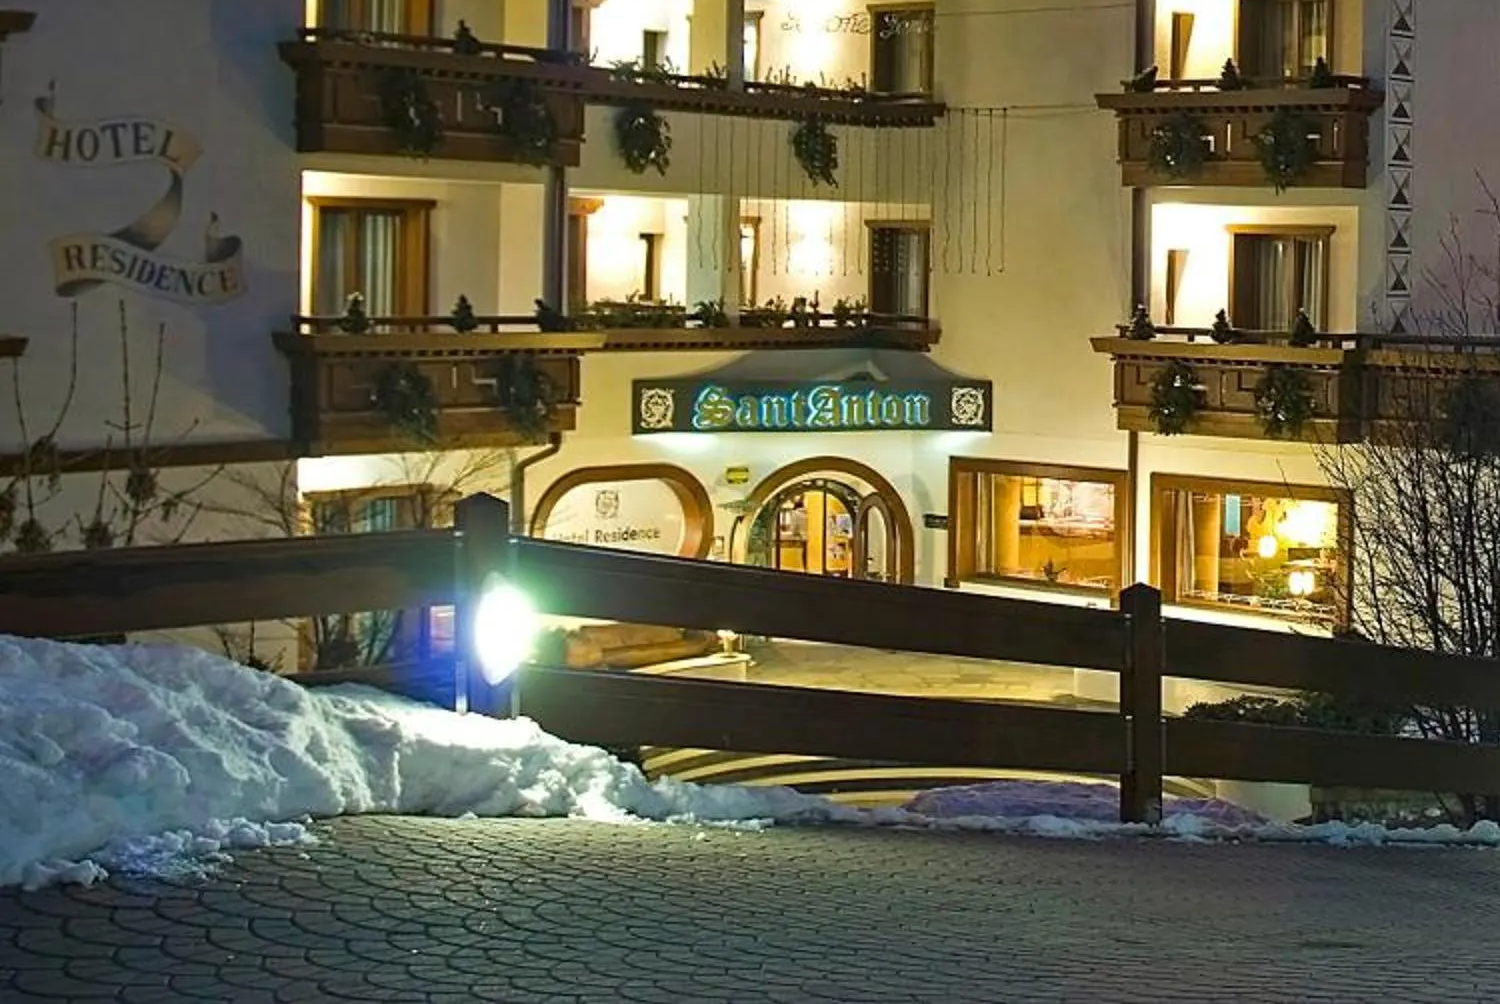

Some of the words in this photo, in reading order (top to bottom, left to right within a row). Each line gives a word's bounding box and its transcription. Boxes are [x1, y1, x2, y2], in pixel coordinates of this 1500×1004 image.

[46, 123, 180, 163] HOTEL
[63, 243, 239, 296] RESIDENCE
[595, 526, 660, 543] Residence
